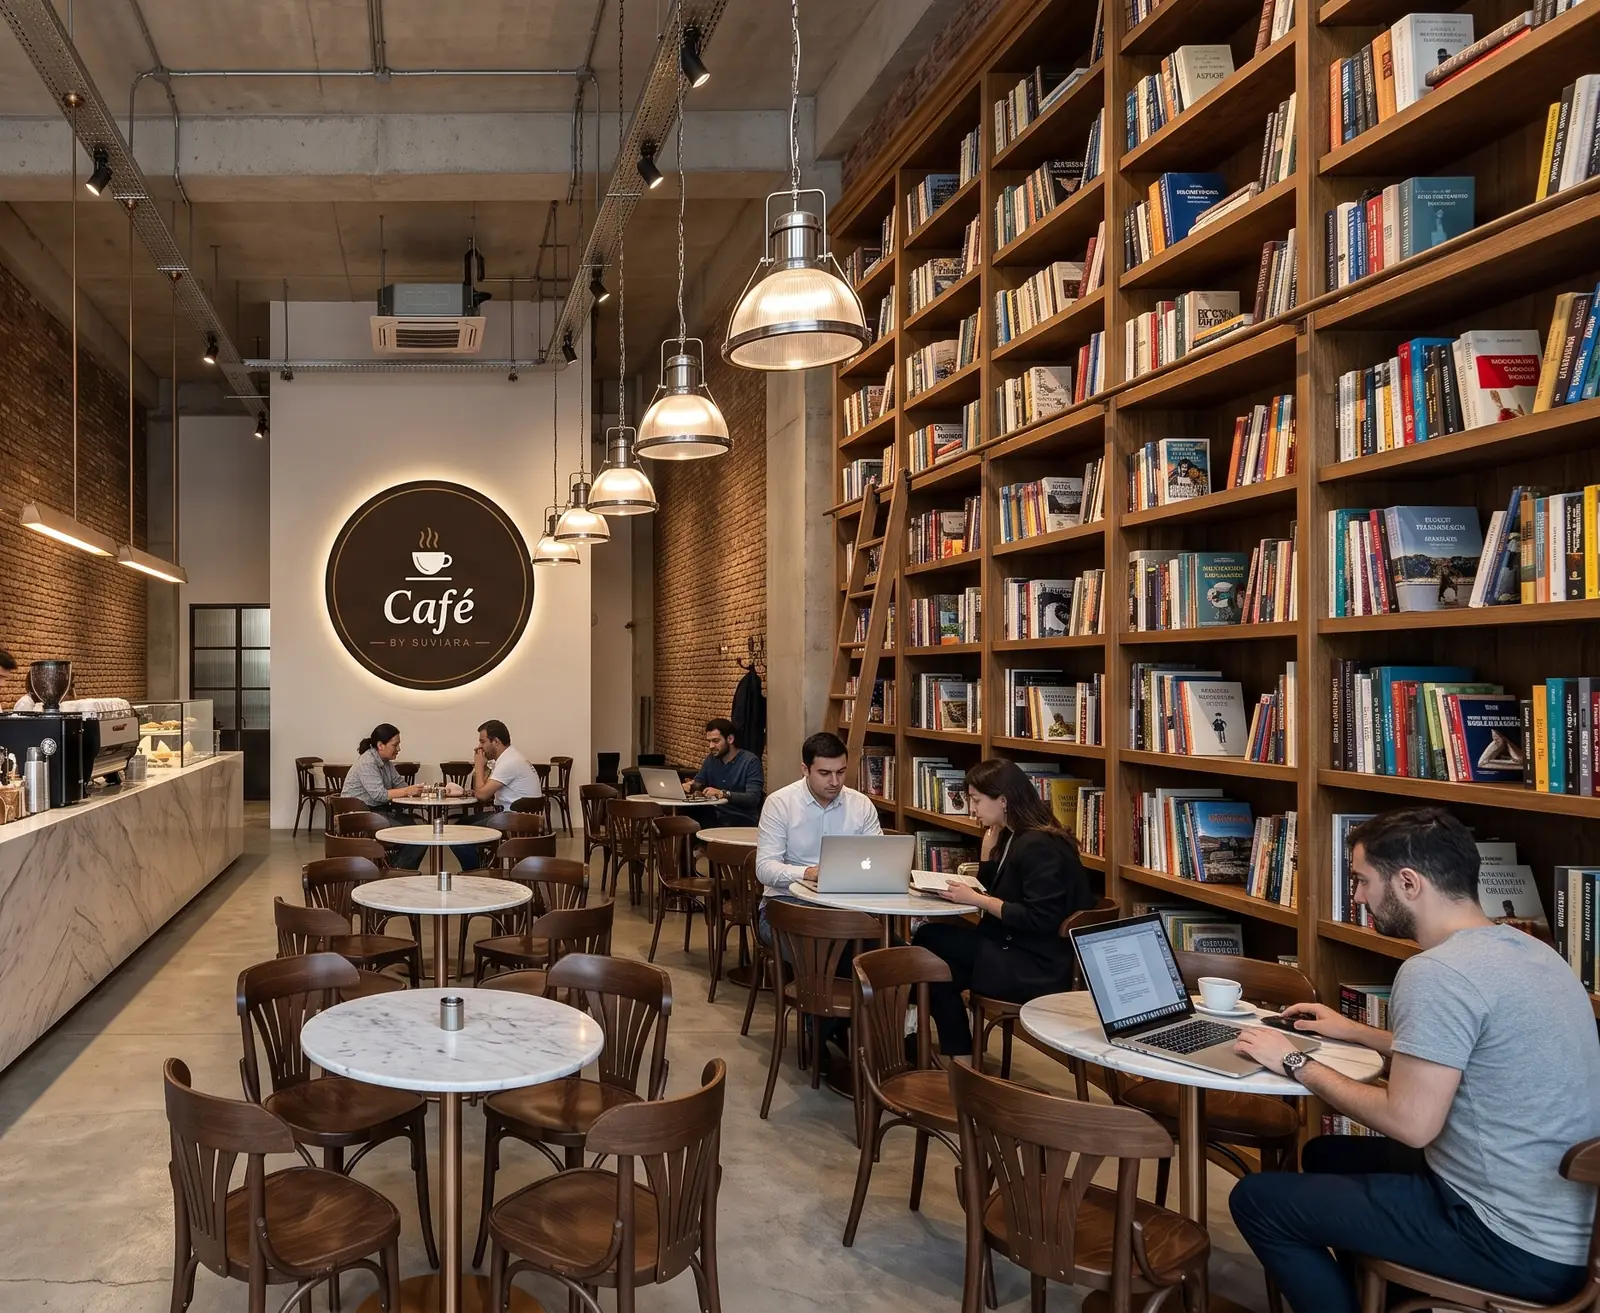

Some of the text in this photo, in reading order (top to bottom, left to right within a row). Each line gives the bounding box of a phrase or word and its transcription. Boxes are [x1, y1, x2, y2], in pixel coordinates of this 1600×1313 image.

[384, 588, 475, 635] Café
[389, 638, 470, 647] BY SUVIARA
